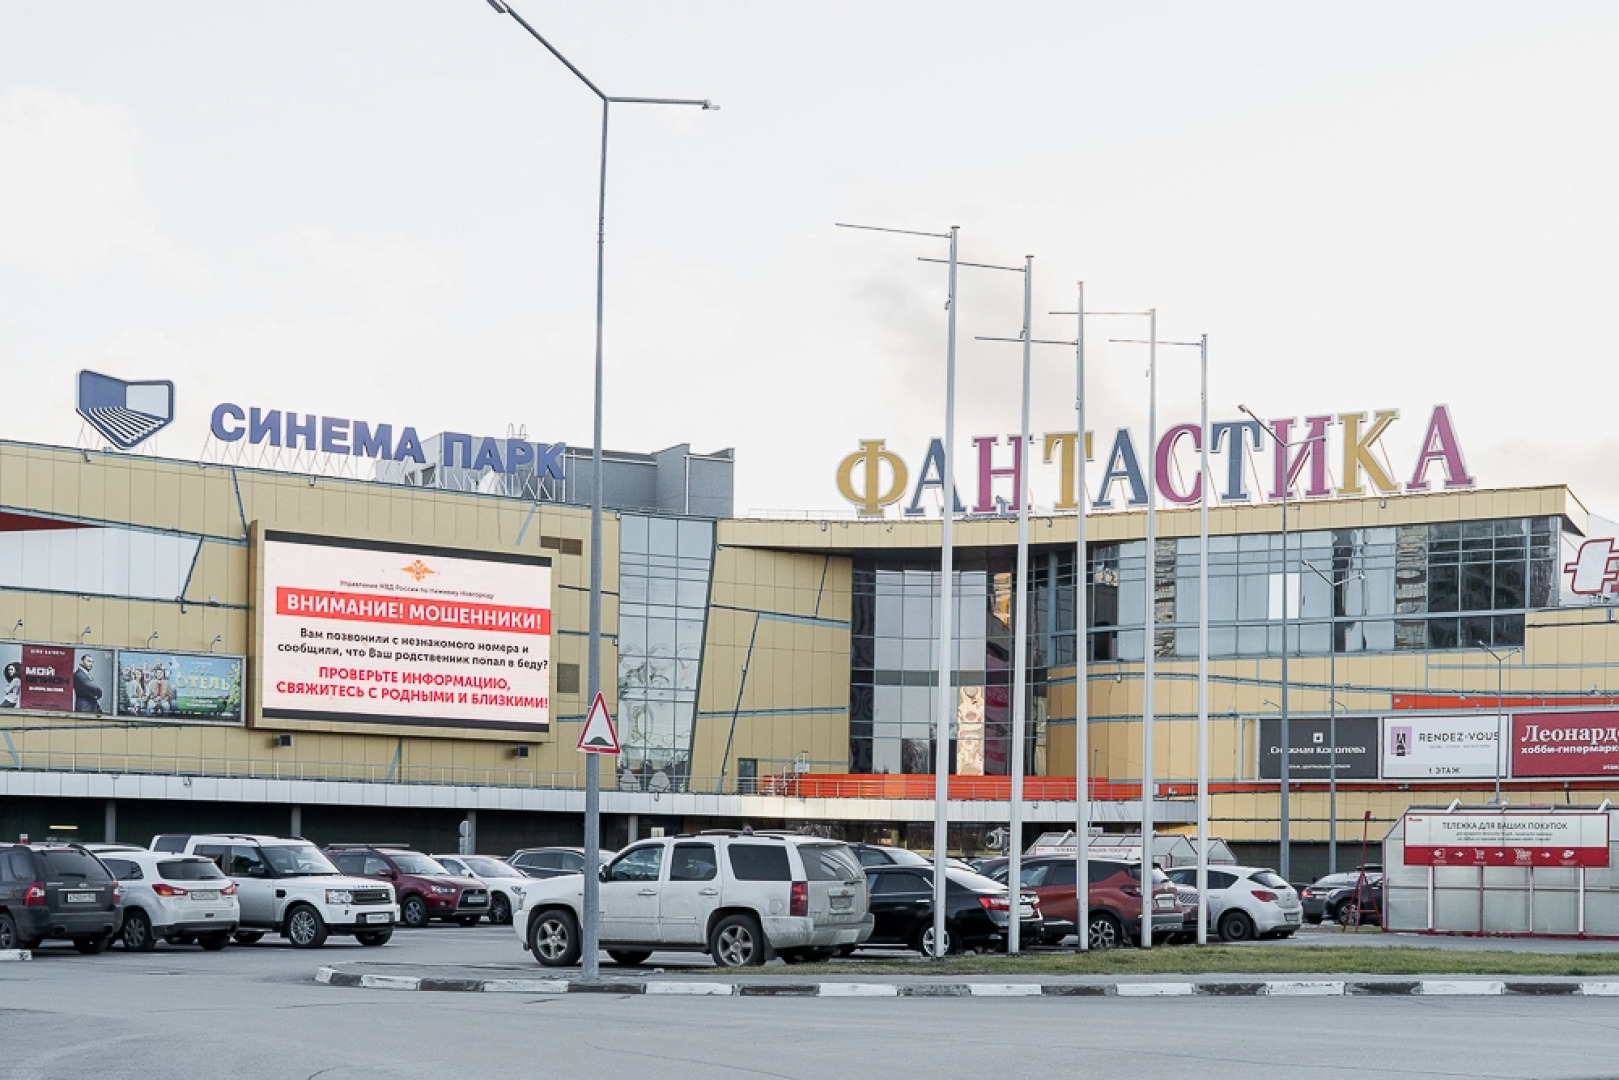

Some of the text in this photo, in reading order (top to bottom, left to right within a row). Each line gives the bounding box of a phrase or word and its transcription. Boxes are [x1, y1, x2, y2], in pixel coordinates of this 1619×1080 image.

[210, 402, 565, 479] СИНЕМА ПАРК
[835, 403, 1477, 519] ФАНТАСТИКА
[287, 593, 541, 629] ВНИМАНИЕ! МОШЕННИКИ!
[300, 627, 323, 639] Вам
[327, 632, 389, 644] позвонили
[392, 637, 398, 645] с
[401, 637, 475, 650] незнакомого
[478, 642, 518, 655] номера
[277, 642, 548, 671] сообщили, что Ваш родственник попал в беду?
[25, 666, 55, 676] МОЙ
[319, 666, 510, 691] ПРОВЕРЬТЕ ИНФОРМАЦИЮ,
[276, 681, 548, 709] СВЯЖИТЕСЬ С РОДНЫМИ И БЛИЗКИМИ!
[1418, 731, 1500, 743] RENDEZ-VOUS
[1442, 822, 1568, 831] ТЕЛЕЖКА ДЛЯ ВАШИХ ПОКУПОК
